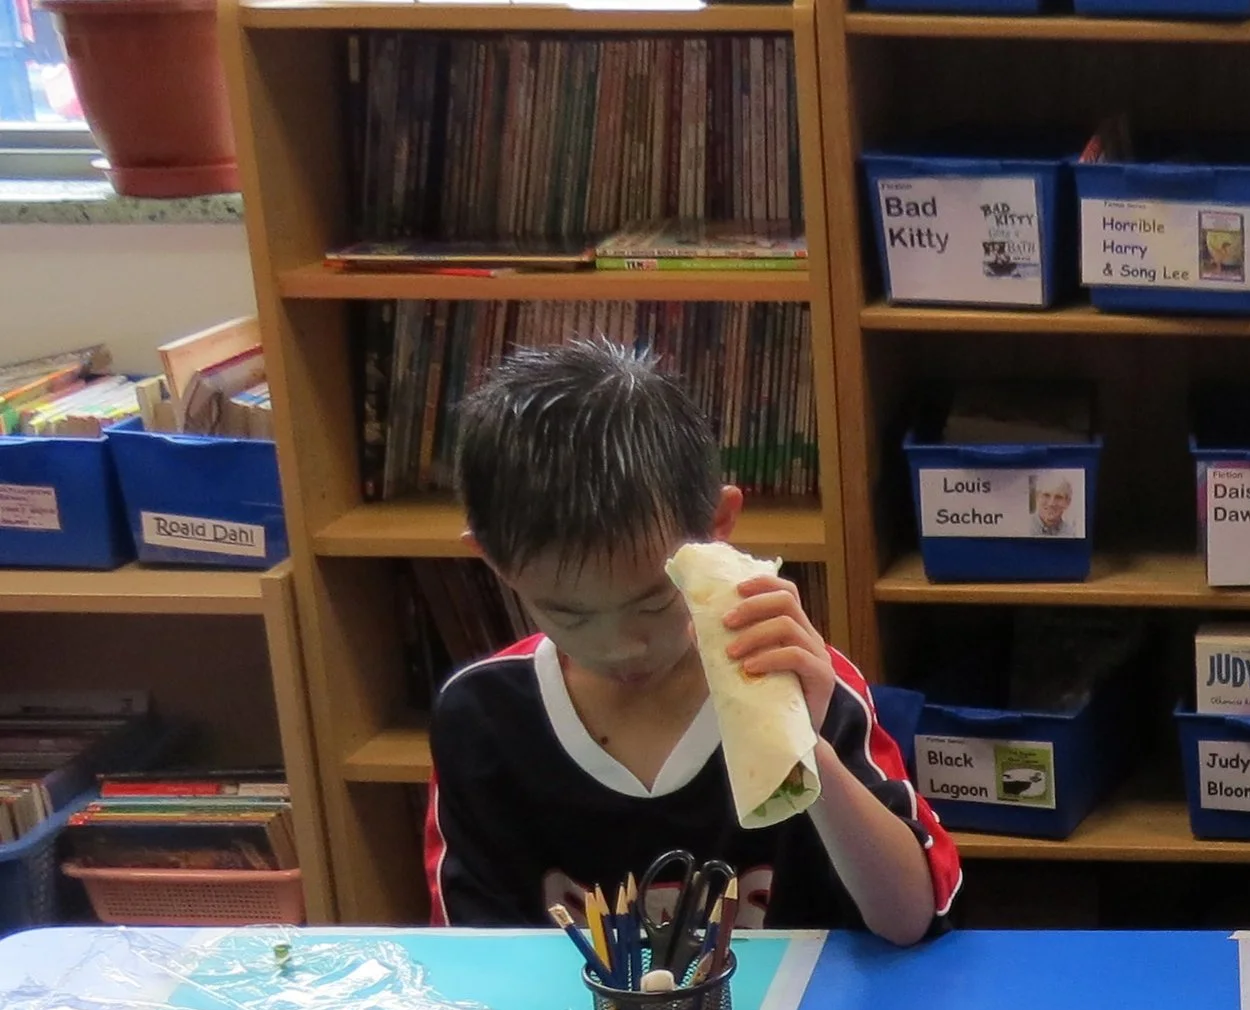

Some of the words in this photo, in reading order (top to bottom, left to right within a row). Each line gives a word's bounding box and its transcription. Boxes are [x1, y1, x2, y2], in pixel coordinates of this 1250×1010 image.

[884, 196, 938, 218] Bad
[980, 202, 1011, 218] BAD
[1102, 216, 1165, 234] Horrible
[888, 227, 949, 254] Kitty
[1102, 239, 1148, 260] Harry
[1102, 262, 1113, 277] &
[1120, 263, 1157, 282] Song
[1163, 265, 1189, 281] Lee
[1212, 470, 1243, 479] Fiction
[943, 477, 991, 493] Louis
[935, 507, 1004, 525] Sachar
[152, 516, 207, 537] Roald
[213, 523, 255, 544] Dahl
[928, 750, 974, 768] Black
[1206, 753, 1250, 773] Judy
[930, 778, 989, 799] Lagoon
